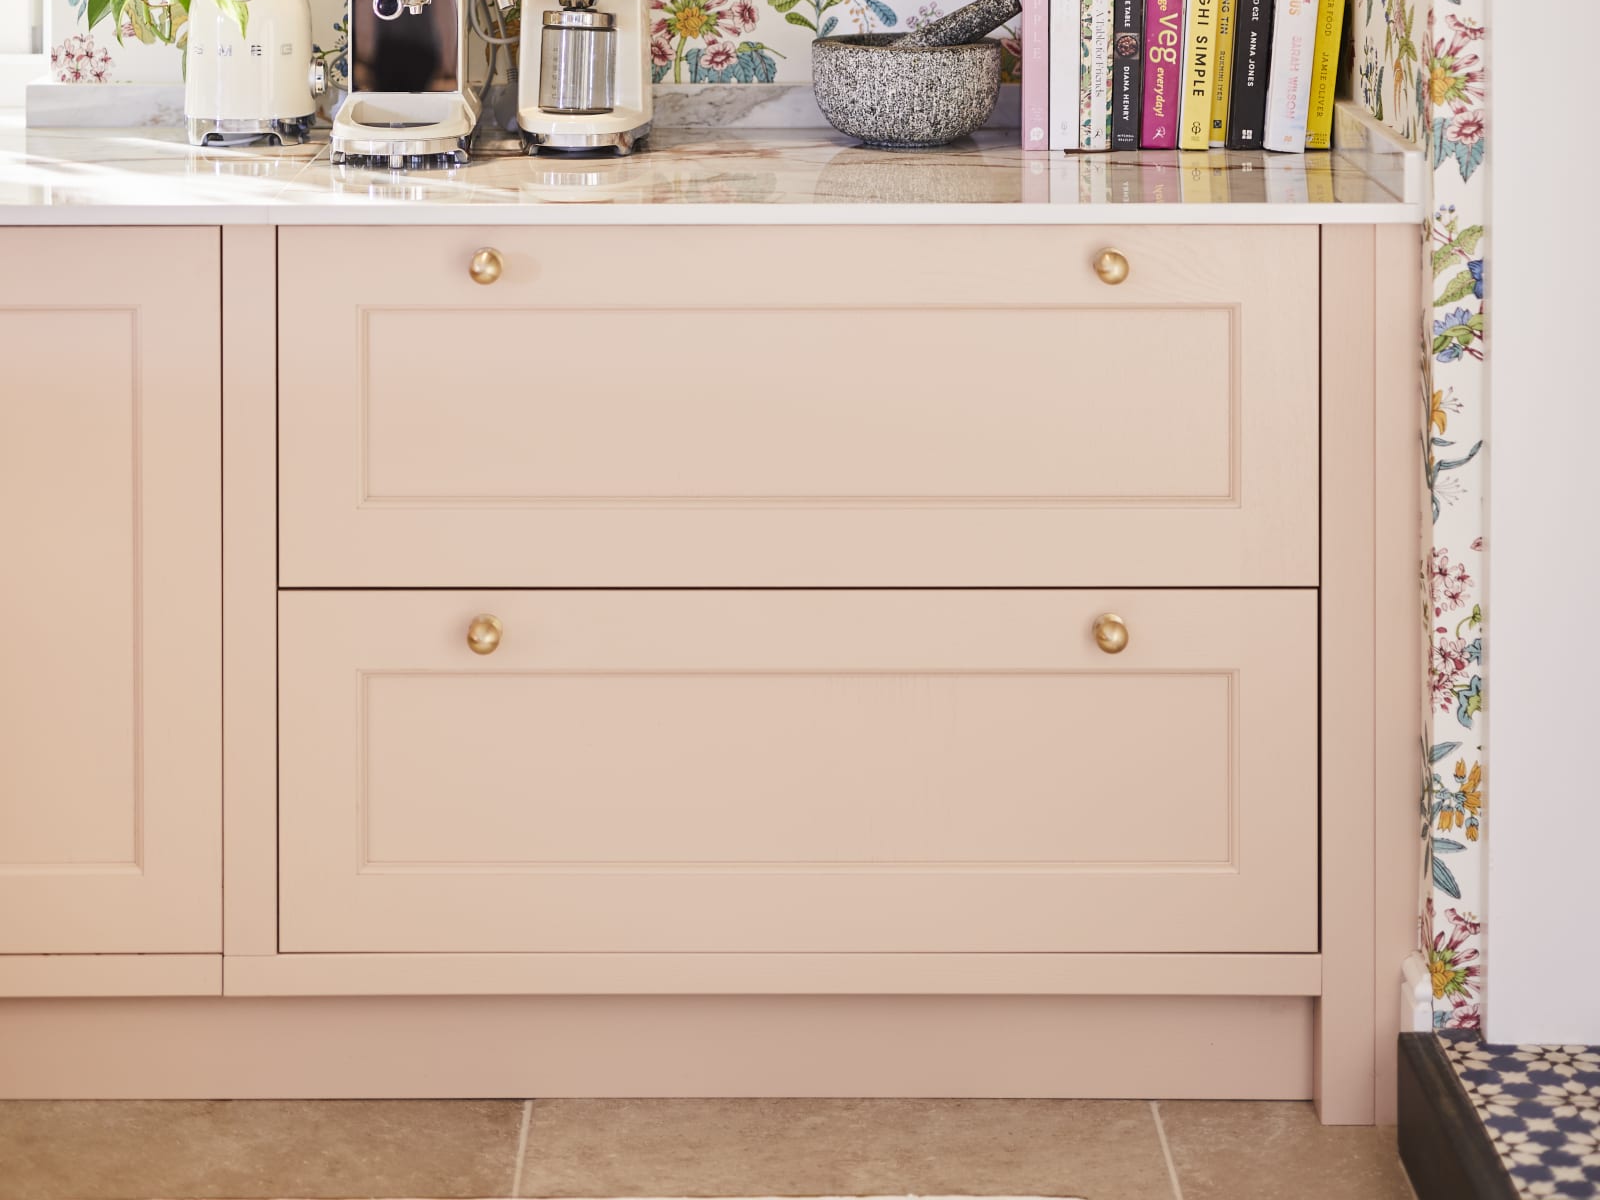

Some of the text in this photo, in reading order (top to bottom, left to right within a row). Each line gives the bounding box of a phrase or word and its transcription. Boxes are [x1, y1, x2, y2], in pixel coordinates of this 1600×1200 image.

[1096, 9, 1104, 18] A
[1220, 17, 1228, 35] TIN
[1251, 6, 1259, 21] eat
[1324, 10, 1334, 37] FOOD
[1192, 35, 1208, 97] SIMPLE
[1248, 31, 1258, 87] ANNA JONES
[1095, 62, 1105, 98] Friends
[1152, 67, 1166, 118] everyday!
[1286, 36, 1302, 120] SARAH WILSON
[1316, 52, 1329, 117] JAMIE OLIVER
[1122, 94, 1130, 120] HENRY
